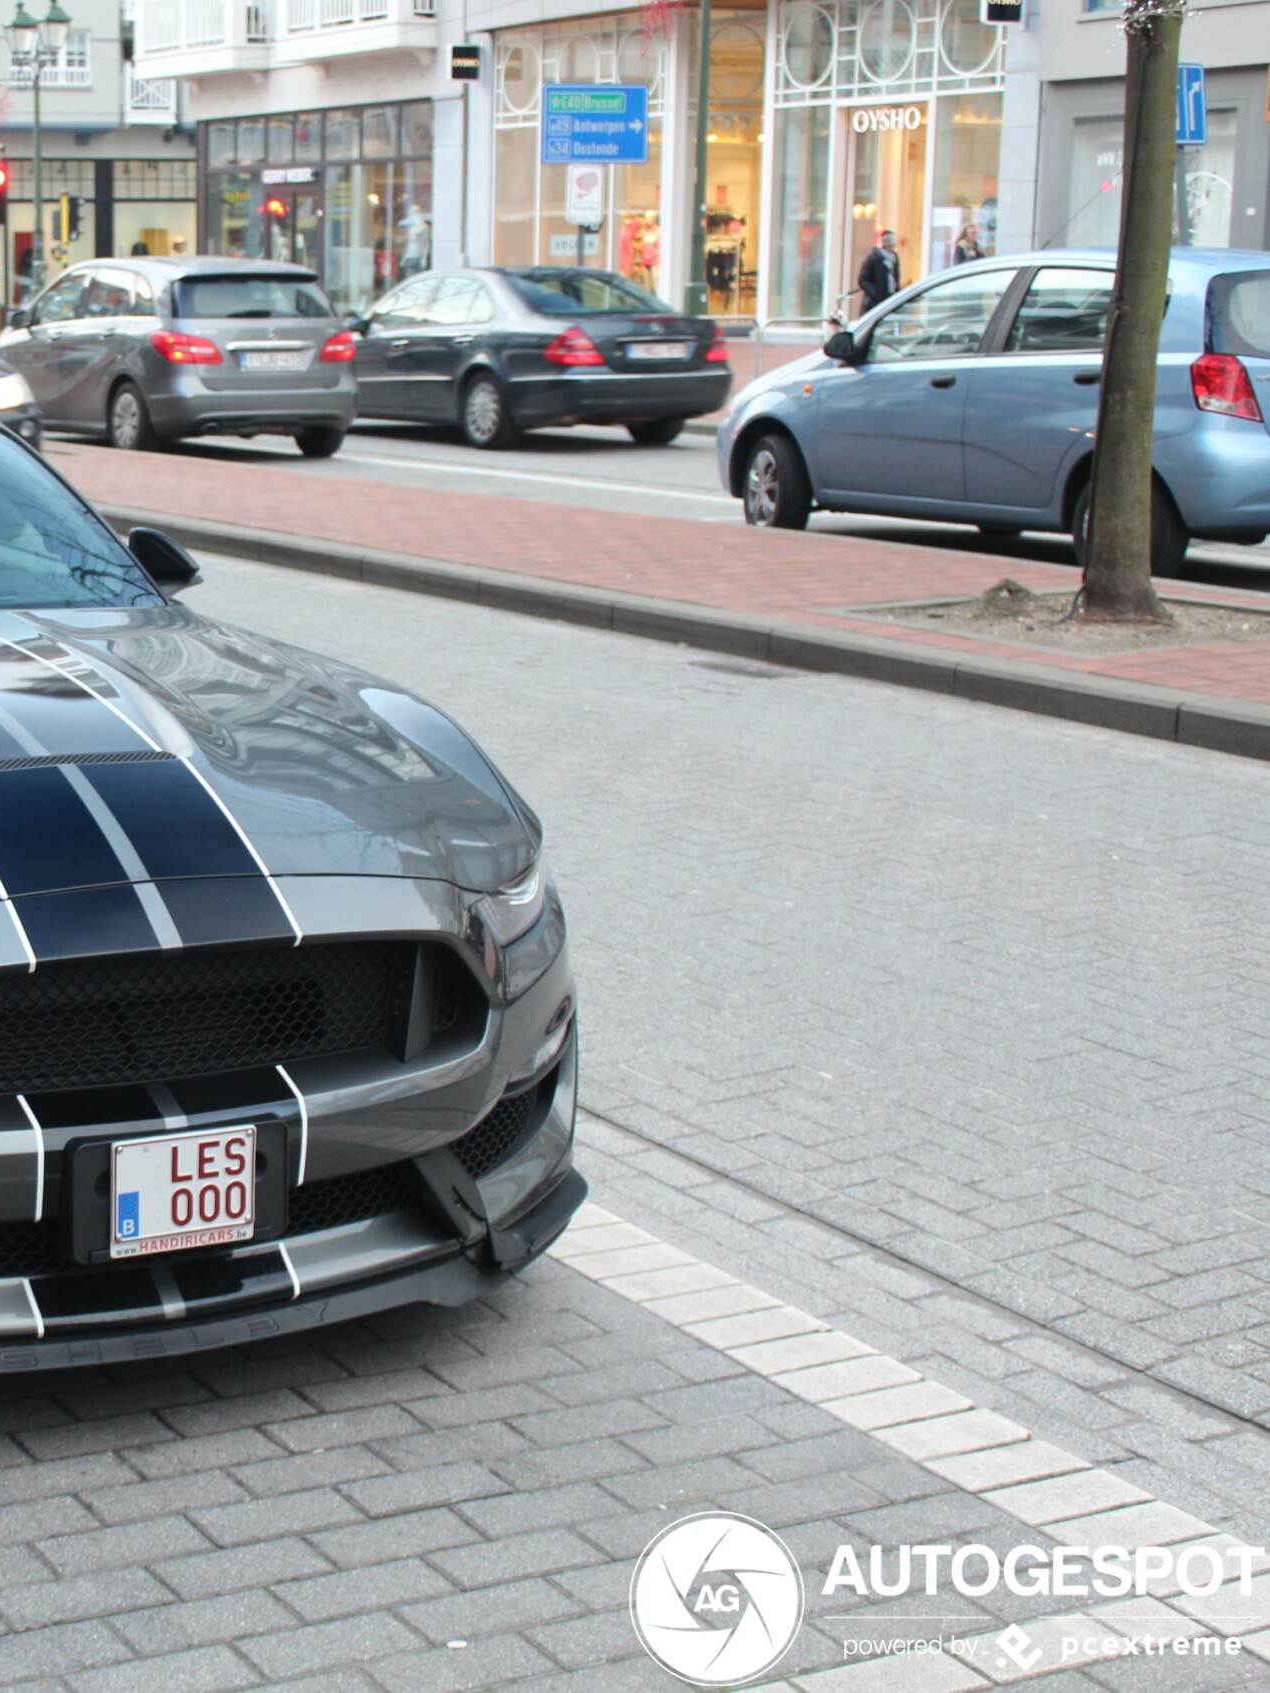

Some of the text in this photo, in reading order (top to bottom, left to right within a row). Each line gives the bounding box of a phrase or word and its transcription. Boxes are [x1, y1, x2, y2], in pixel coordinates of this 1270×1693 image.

[562, 93, 623, 110] E40 Brussel
[574, 119, 626, 136] Antwerpen
[852, 106, 922, 133] OYSHO
[574, 141, 619, 155] Oostende
[171, 1137, 246, 1183] LES
[171, 1180, 246, 1227] 000
[122, 1219, 135, 1236] B
[116, 1229, 247, 1257] www.HANDIRICARS.be
